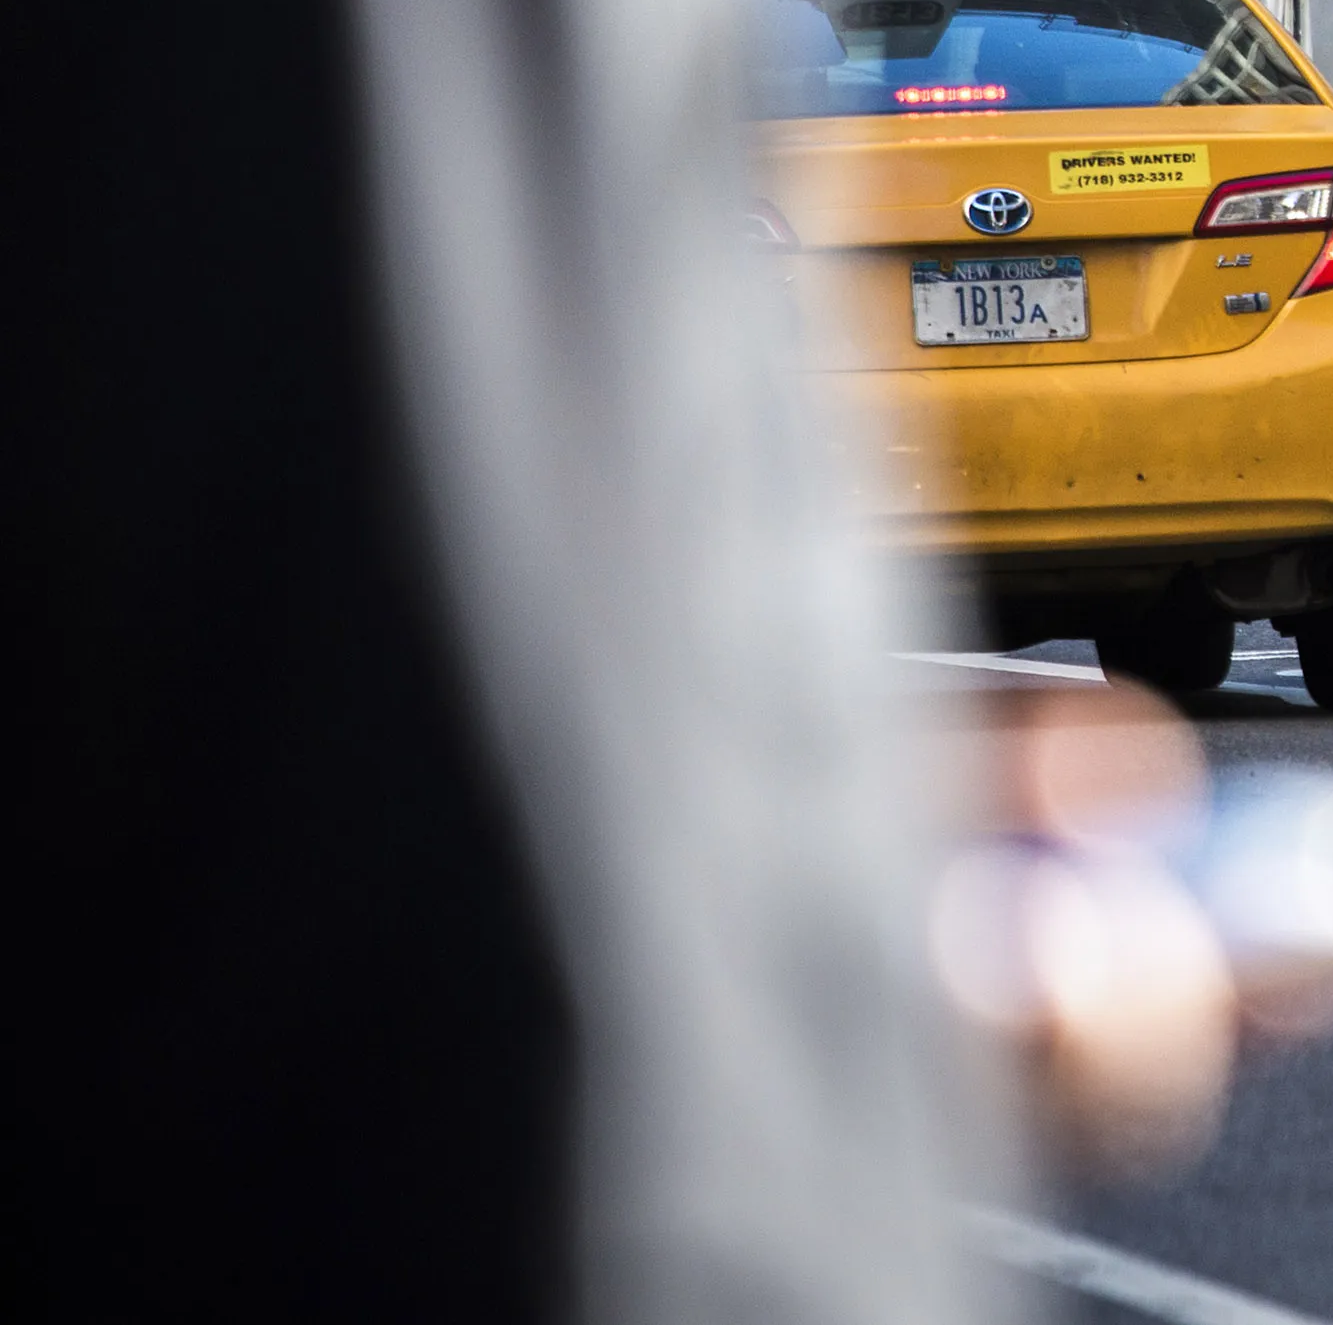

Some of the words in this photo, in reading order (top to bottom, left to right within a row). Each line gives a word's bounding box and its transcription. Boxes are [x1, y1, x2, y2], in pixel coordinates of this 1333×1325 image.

[1061, 155, 1125, 170] DRIVERS
[1130, 152, 1196, 166] WANTED!
[1077, 175, 1114, 188] (718)
[1119, 171, 1183, 184] 932-3312
[1215, 253, 1253, 269] LE
[953, 262, 991, 281] NEW
[999, 261, 1042, 278] YORK
[955, 284, 1048, 326] 1B13A
[986, 328, 1015, 340] TAXI
